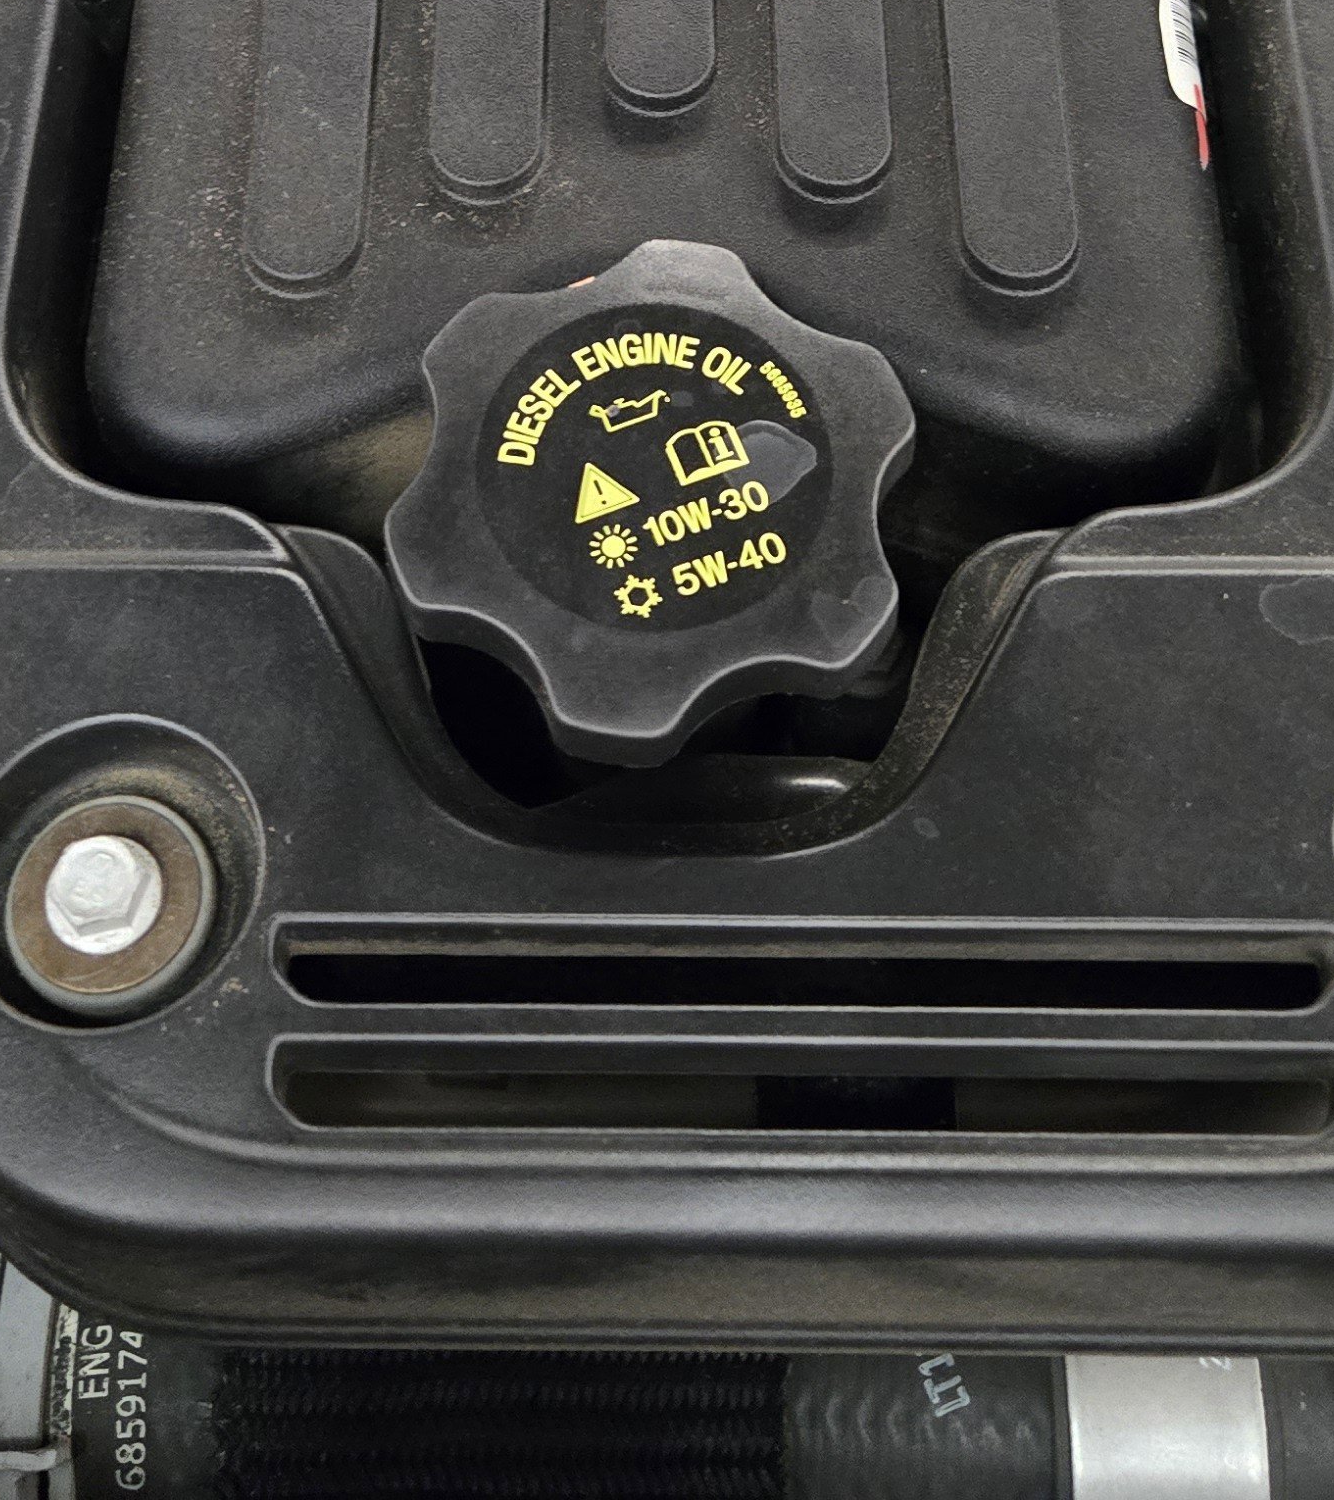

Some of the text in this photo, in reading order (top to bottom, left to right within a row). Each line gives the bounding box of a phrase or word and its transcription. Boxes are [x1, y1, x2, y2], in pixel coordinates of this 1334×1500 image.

[497, 368, 582, 466] DIESEL
[571, 333, 701, 381] ENGINE
[701, 346, 752, 396] OIL
[642, 480, 770, 547] 10W-30
[671, 532, 788, 596] 5W-40
[78, 1324, 113, 1399] ENG
